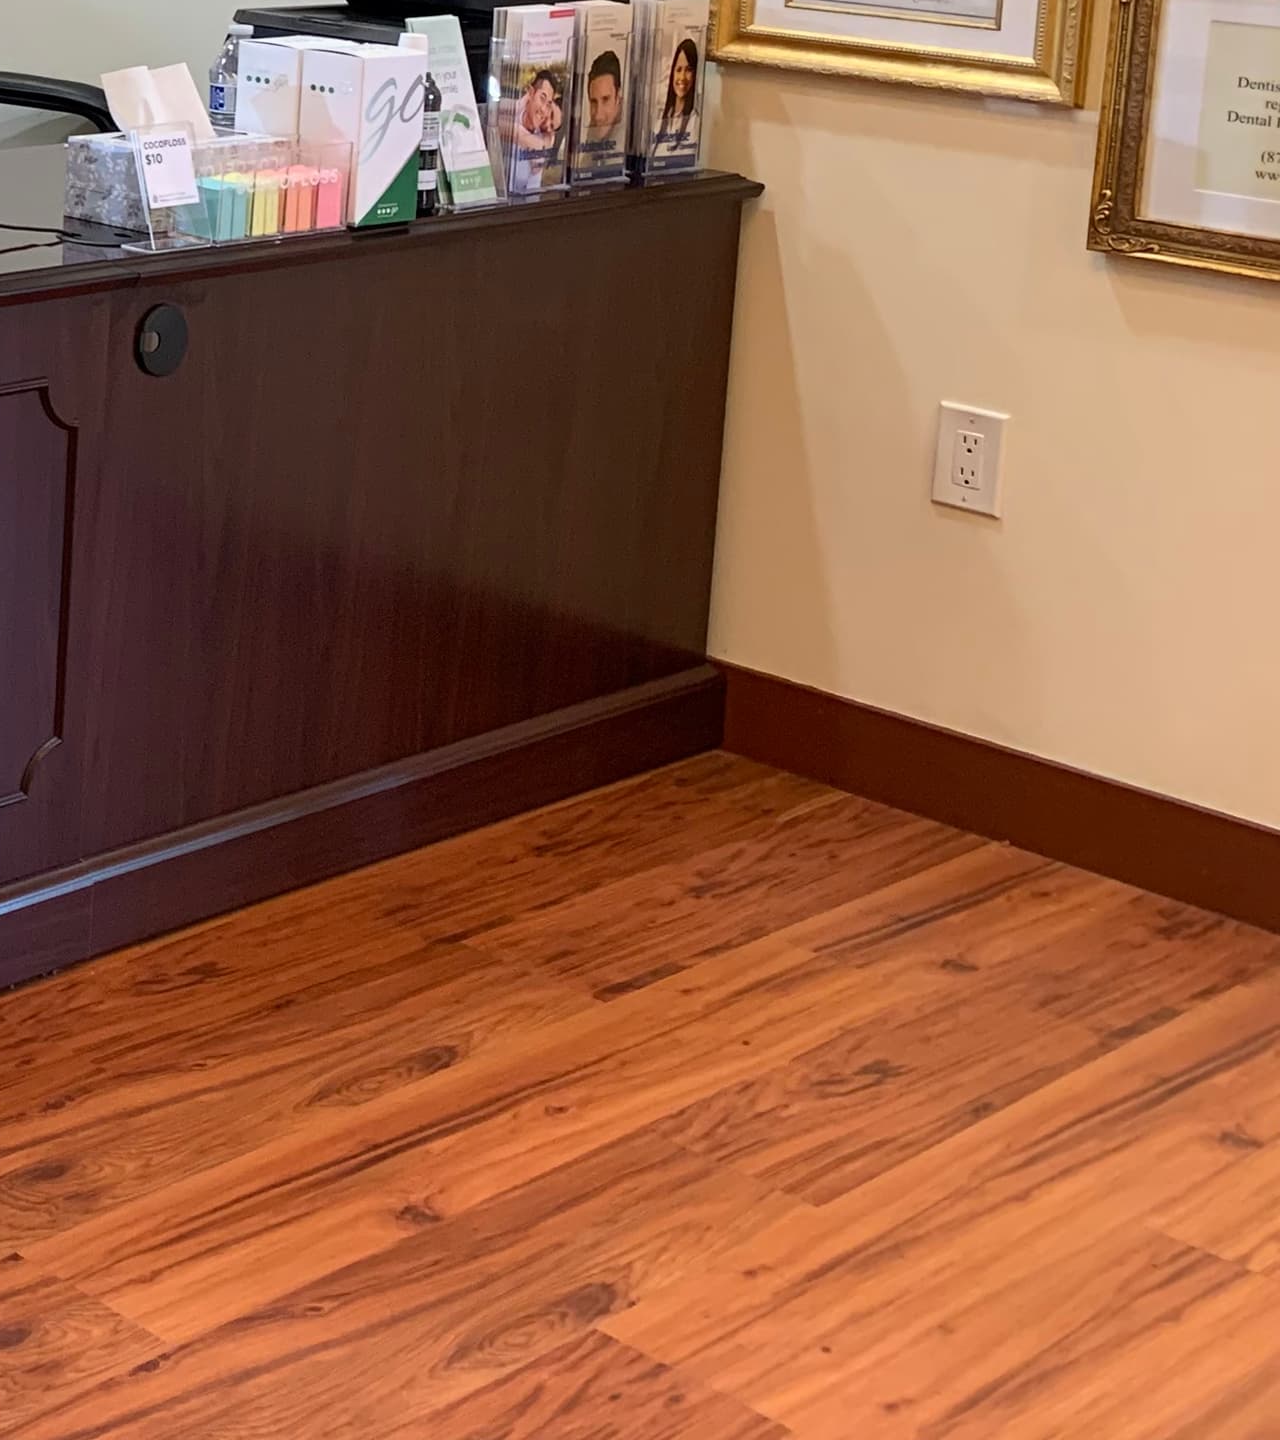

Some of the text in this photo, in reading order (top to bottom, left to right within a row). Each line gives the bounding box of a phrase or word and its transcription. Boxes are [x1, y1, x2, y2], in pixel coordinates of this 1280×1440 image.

[360, 74, 426, 165] go
[1227, 110, 1272, 128] Dental
[143, 137, 187, 150] COCOFLOSS
[145, 152, 163, 166] $10
